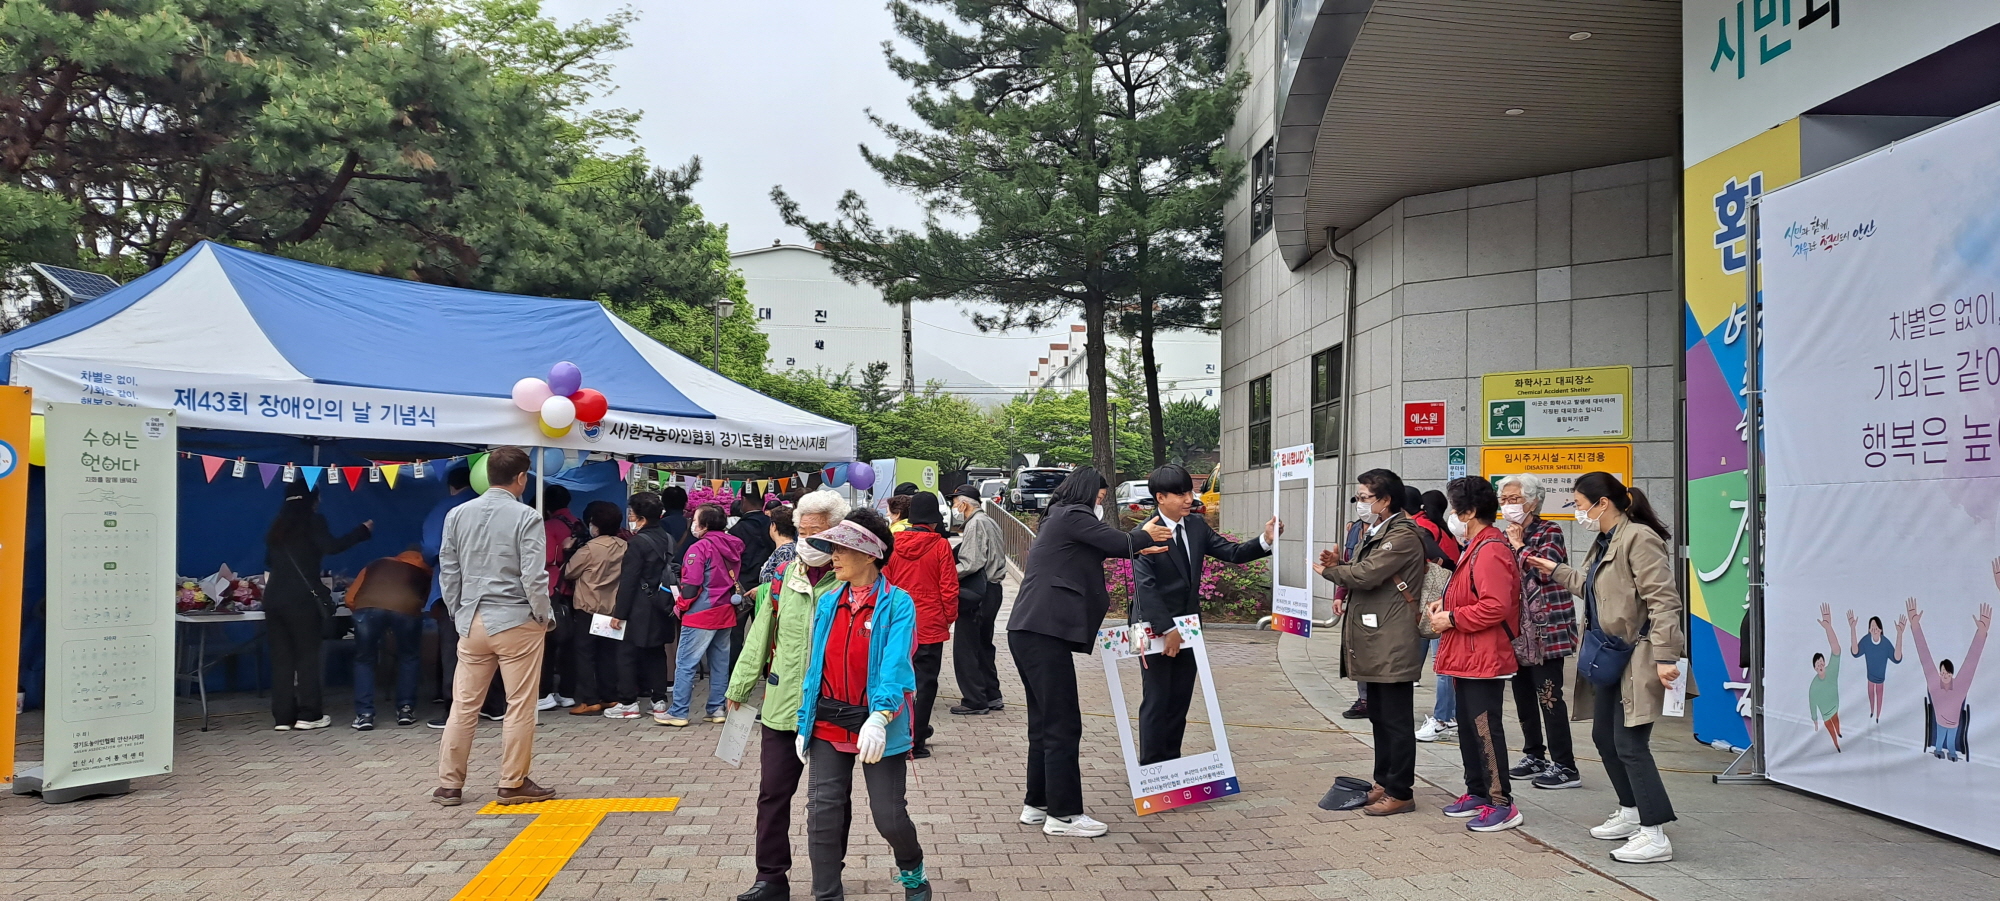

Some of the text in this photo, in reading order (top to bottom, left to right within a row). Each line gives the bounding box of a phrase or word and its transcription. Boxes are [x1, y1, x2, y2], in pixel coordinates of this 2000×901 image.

[1852, 219, 1877, 240] 안산
[1889, 303, 1947, 341] 차별은
[80, 370, 113, 384] 차별은
[1514, 375, 1594, 388] 화학사고 대피장소
[1873, 358, 1946, 401] 기회는
[82, 384, 115, 397] 기회는
[173, 387, 436, 427] 제43회 장애인의 날 기념식
[1410, 412, 1438, 424] 에스원
[82, 428, 139, 449] 수어는
[609, 422, 828, 451] 사)한국농아인협회 경기도협회 안산시지회
[1862, 414, 2000, 468] 행복은 높
[81, 452, 141, 472] 언어다
